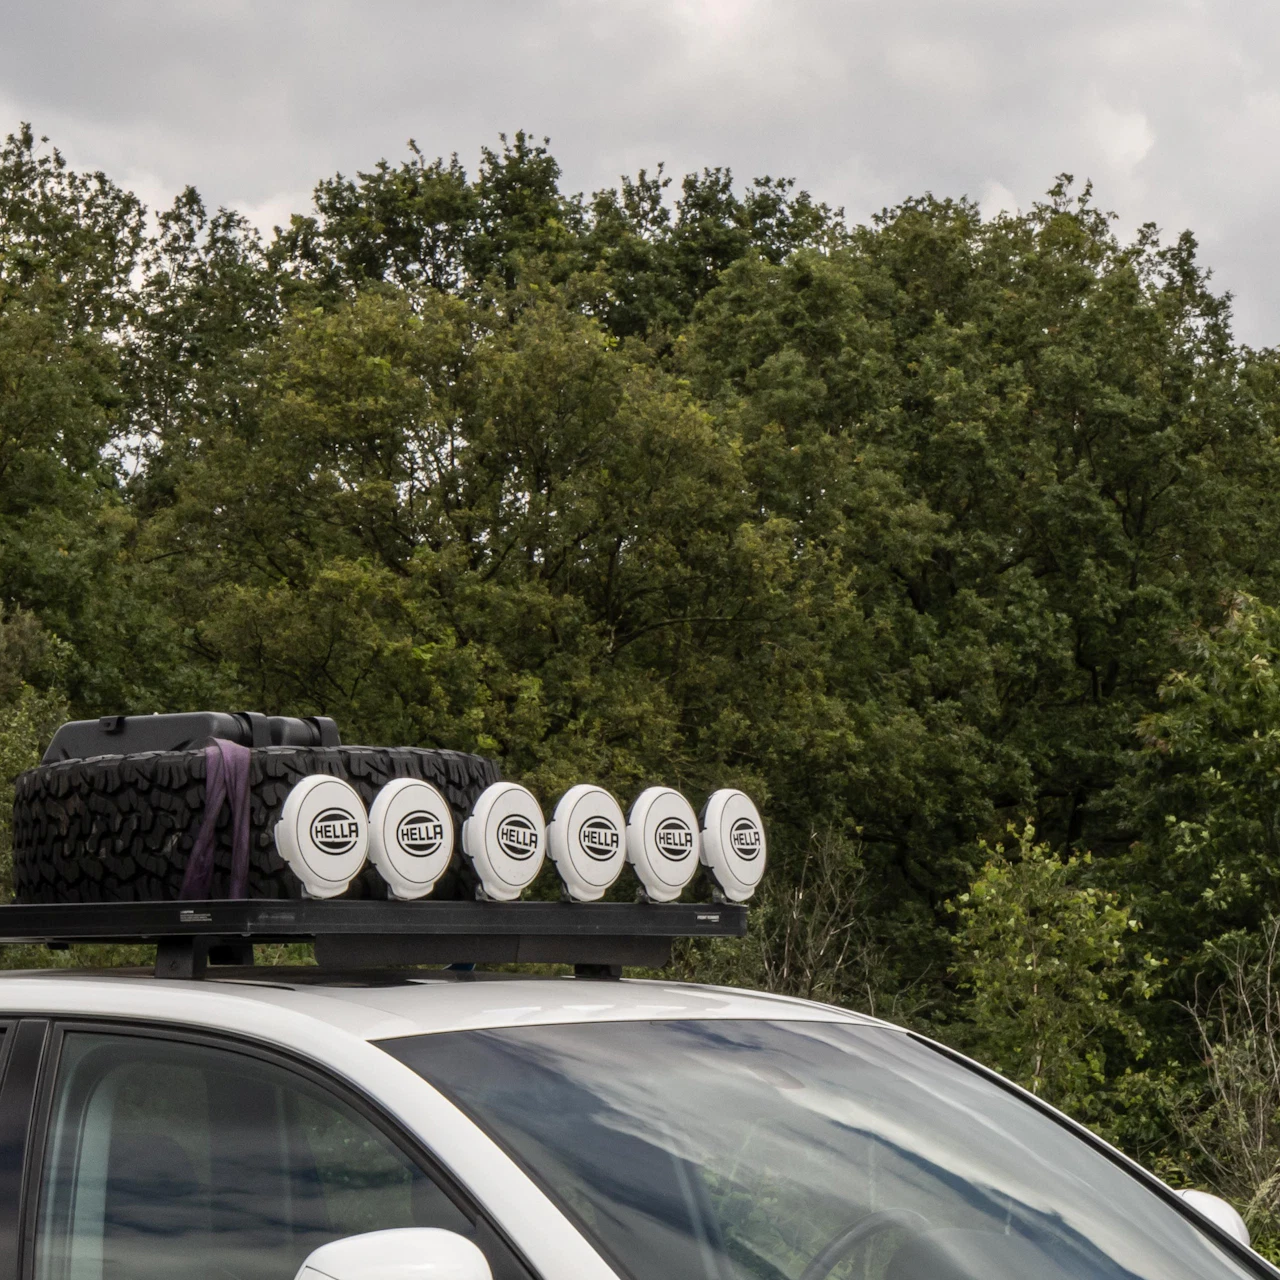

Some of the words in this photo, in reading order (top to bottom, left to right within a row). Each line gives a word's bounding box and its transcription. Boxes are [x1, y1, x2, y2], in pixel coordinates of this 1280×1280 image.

[314, 822, 359, 839] HELLA
[401, 824, 443, 842] HELLA
[501, 827, 538, 849] HELLA
[583, 829, 619, 849] HELLA
[733, 830, 760, 848] HELLA
[658, 831, 693, 849] HELLA
